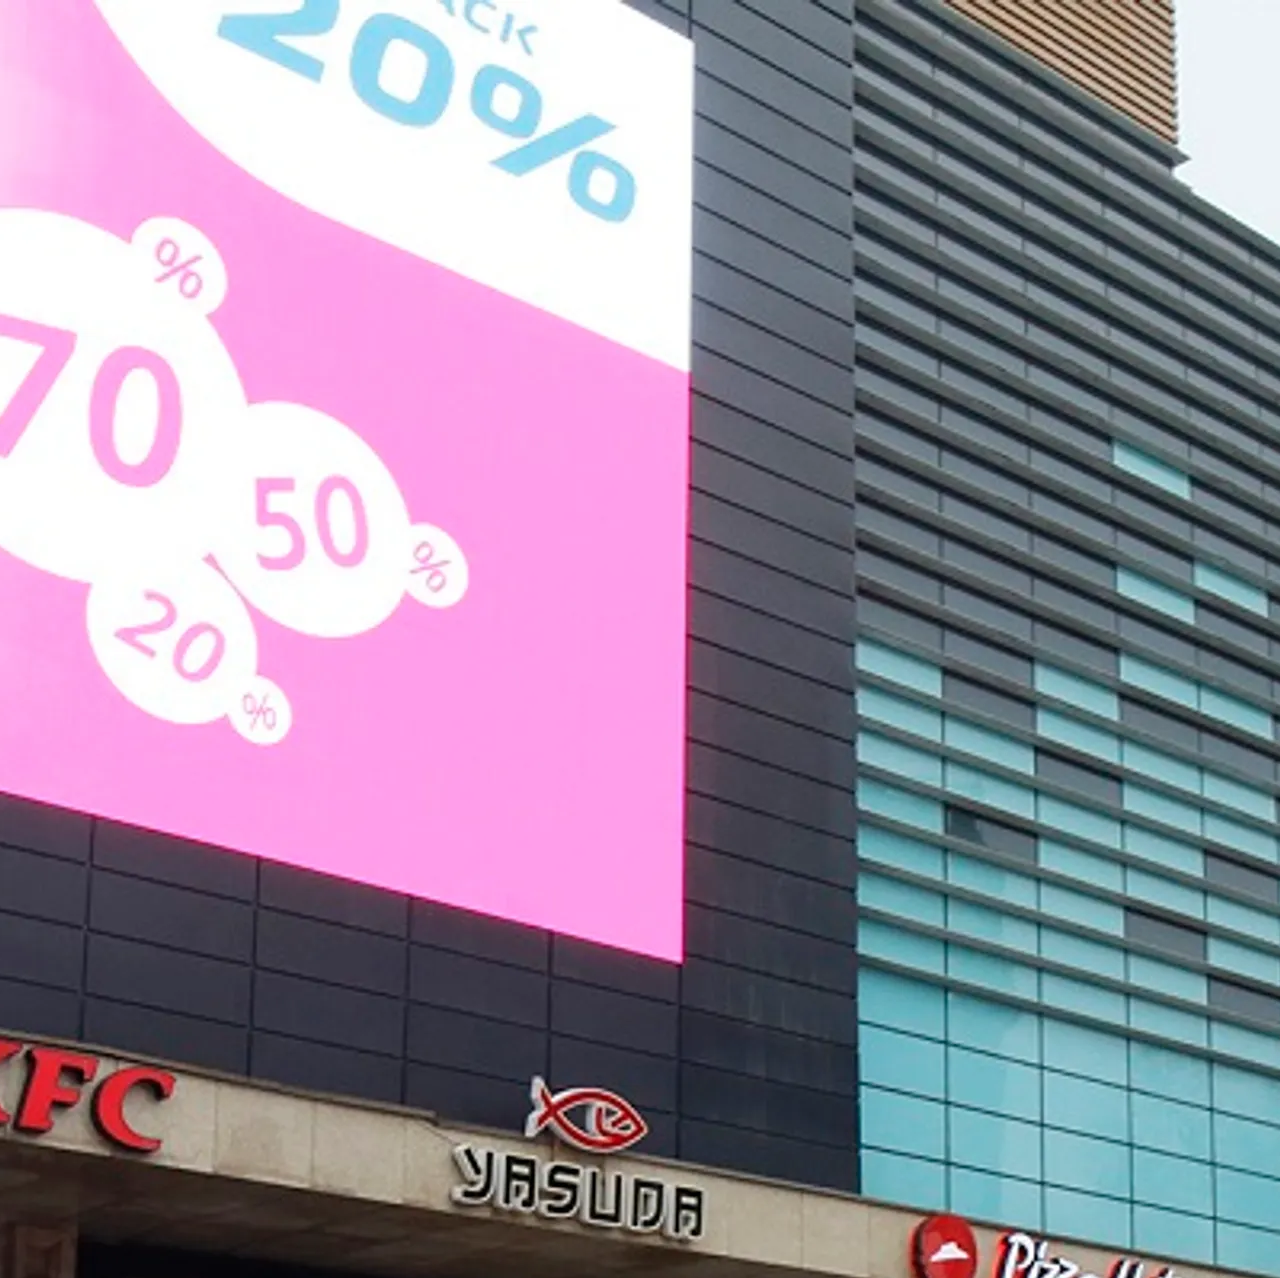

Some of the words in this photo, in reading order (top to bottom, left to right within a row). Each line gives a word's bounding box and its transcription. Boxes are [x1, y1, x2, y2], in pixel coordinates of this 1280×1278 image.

[437, 0, 538, 56] CK
[217, 0, 637, 222] 20%
[154, 238, 204, 299] %
[253, 475, 368, 571] 50
[410, 541, 447, 594] %
[113, 591, 227, 683] 20
[455, 1145, 705, 1238] YASUDA
